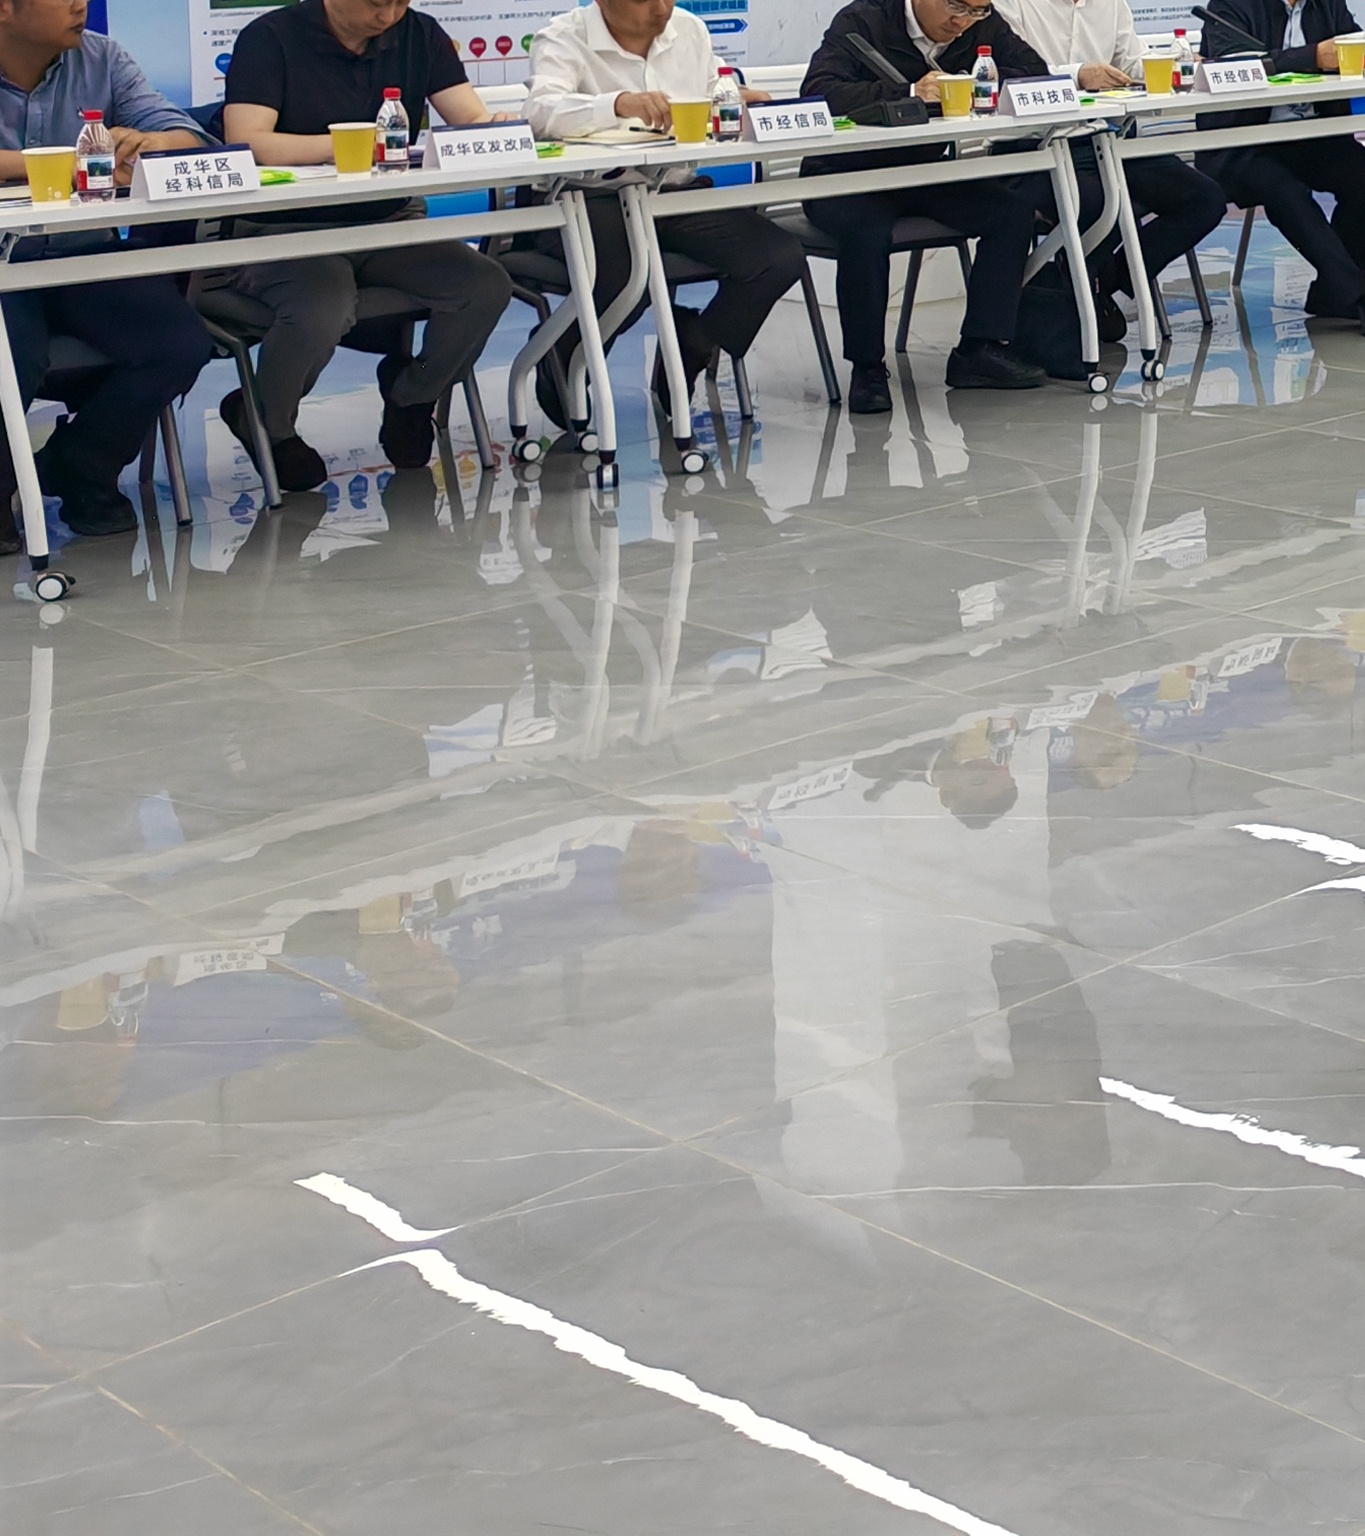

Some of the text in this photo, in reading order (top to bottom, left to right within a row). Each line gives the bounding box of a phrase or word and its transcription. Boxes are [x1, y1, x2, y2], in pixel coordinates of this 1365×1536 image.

[1210, 68, 1264, 85] 市经信局
[1015, 88, 1075, 107] 市科技局
[756, 111, 828, 131] 市经信局
[440, 137, 534, 158] 成华区发改局
[174, 157, 232, 176] 成华区
[165, 172, 244, 194] 经科信局
